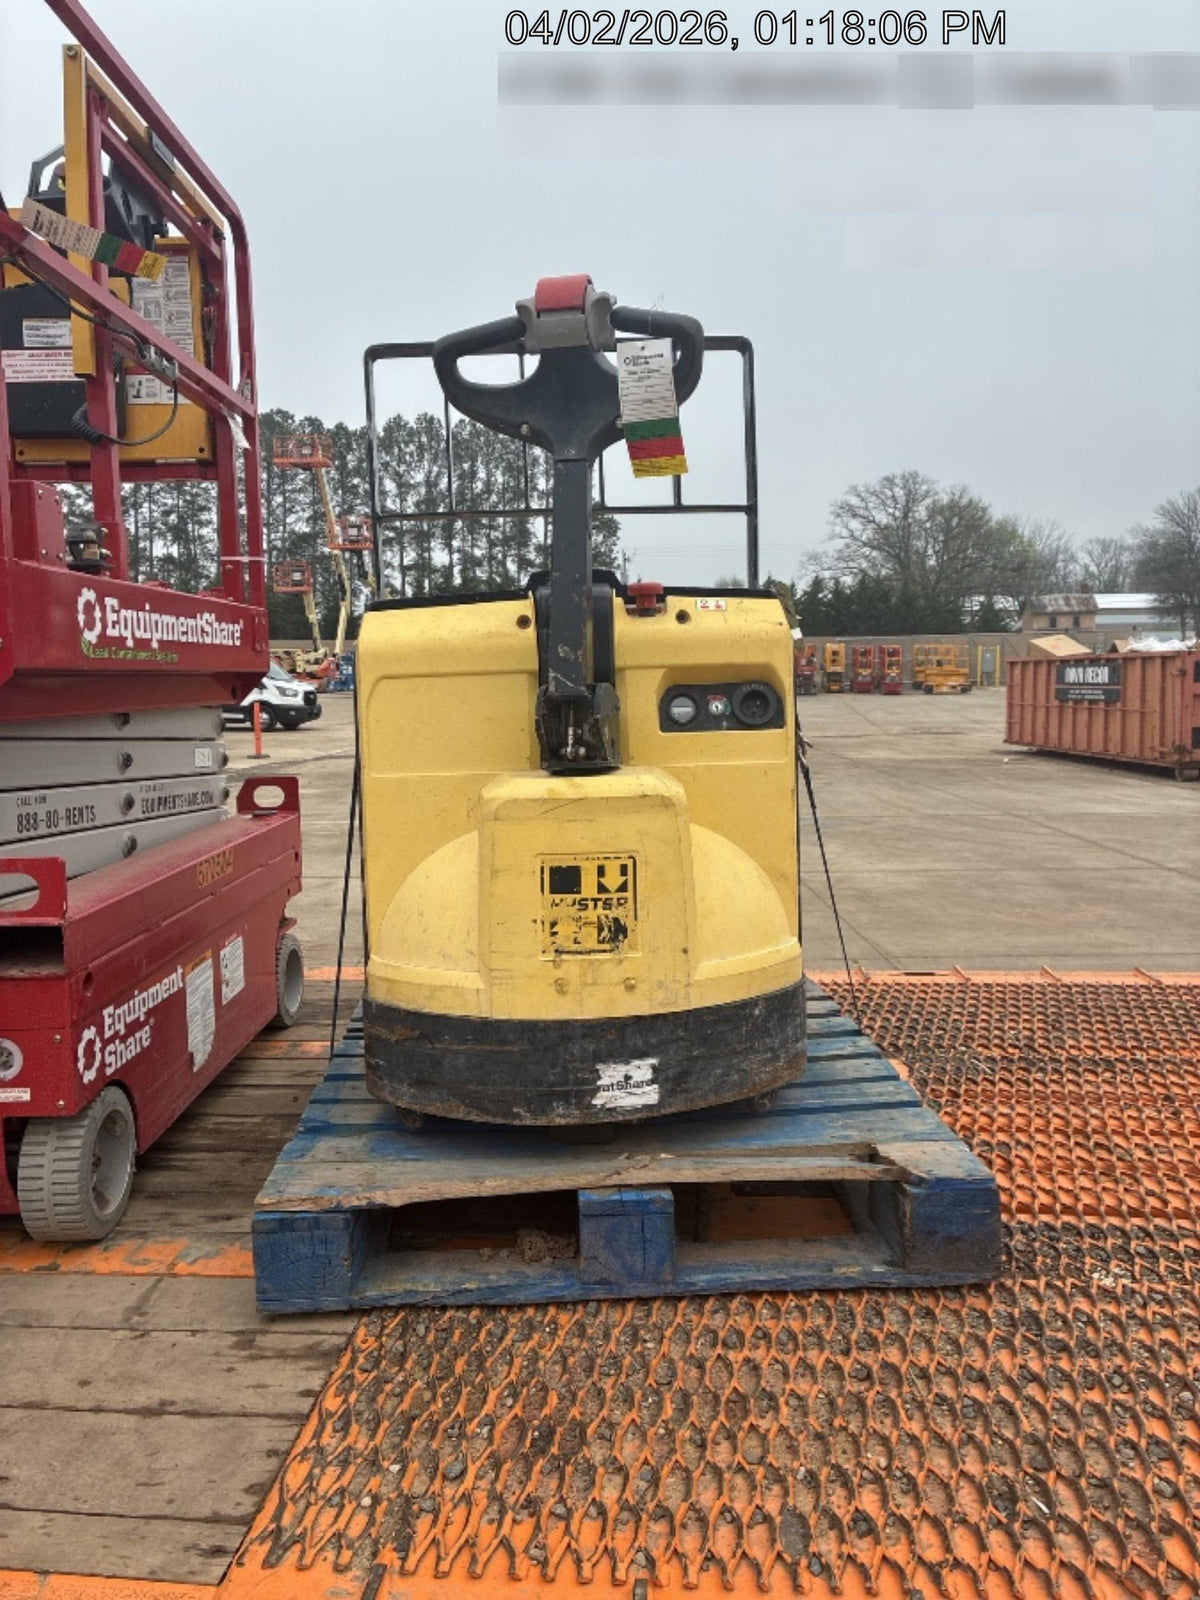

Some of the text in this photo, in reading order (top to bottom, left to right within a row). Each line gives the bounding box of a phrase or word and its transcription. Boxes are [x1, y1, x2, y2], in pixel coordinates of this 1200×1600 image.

[104, 597, 241, 649] EquipmentShare
[16, 804, 97, 834] 888-80-RENTS
[103, 965, 185, 1039] Equipment
[104, 1026, 152, 1077] Share
